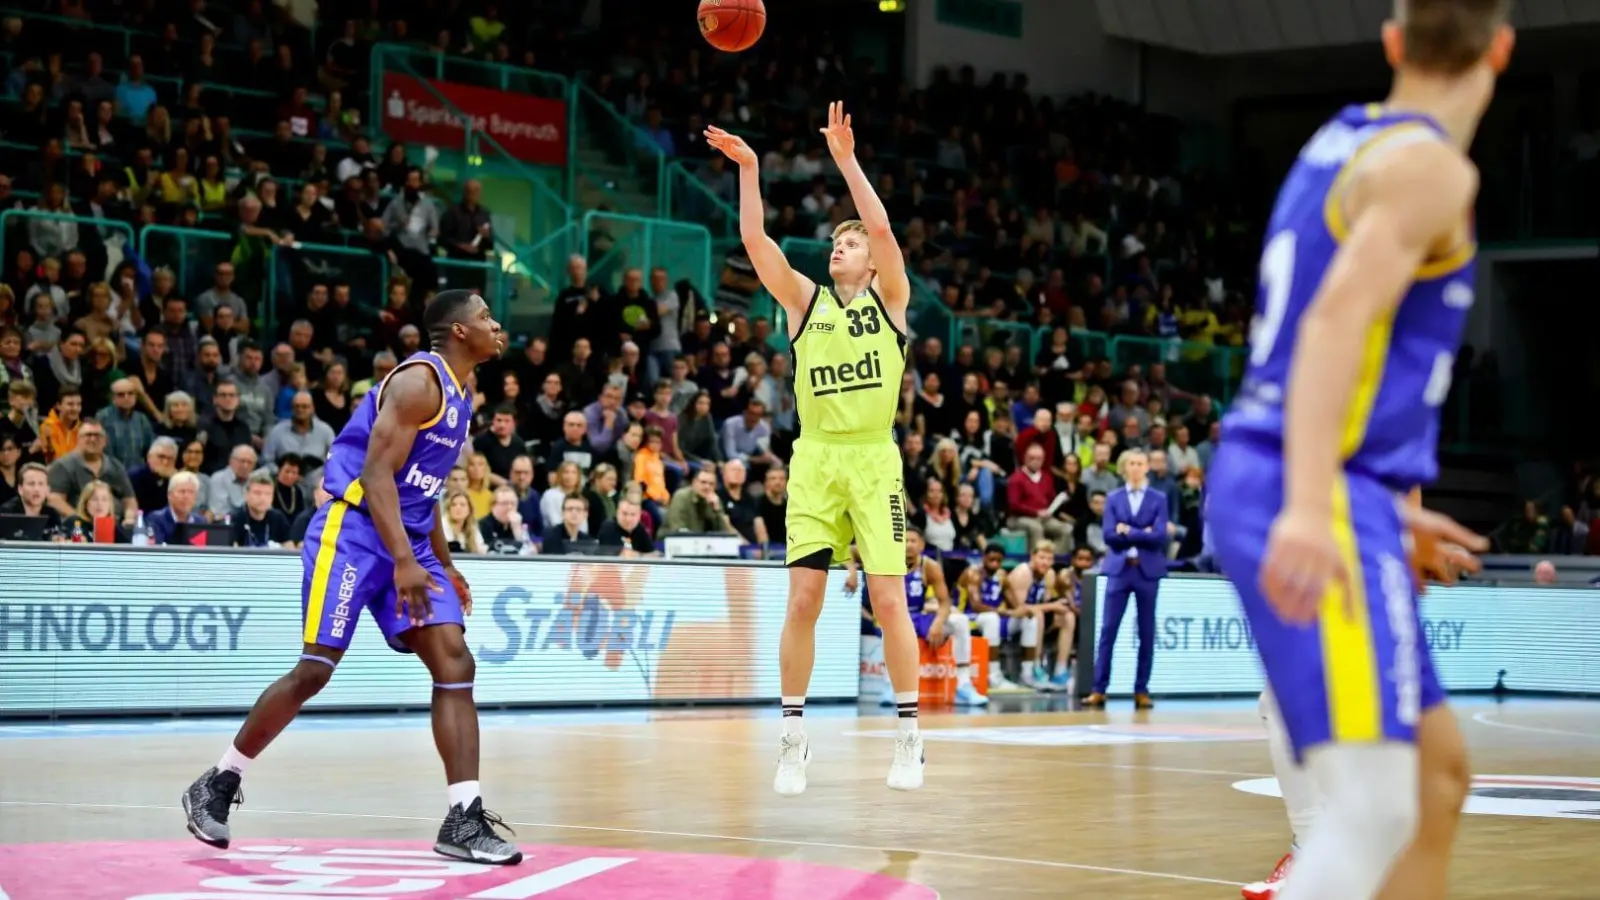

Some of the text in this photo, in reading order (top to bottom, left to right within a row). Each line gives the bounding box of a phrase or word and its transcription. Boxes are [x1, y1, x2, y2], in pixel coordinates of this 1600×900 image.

[407, 100, 559, 141] Sparkase Bayreuth
[845, 306, 881, 338] 33
[809, 350, 882, 388] medi
[405, 463, 448, 497] hey
[889, 494, 904, 543] REHAU
[0, 602, 250, 652] HNOLOGY
